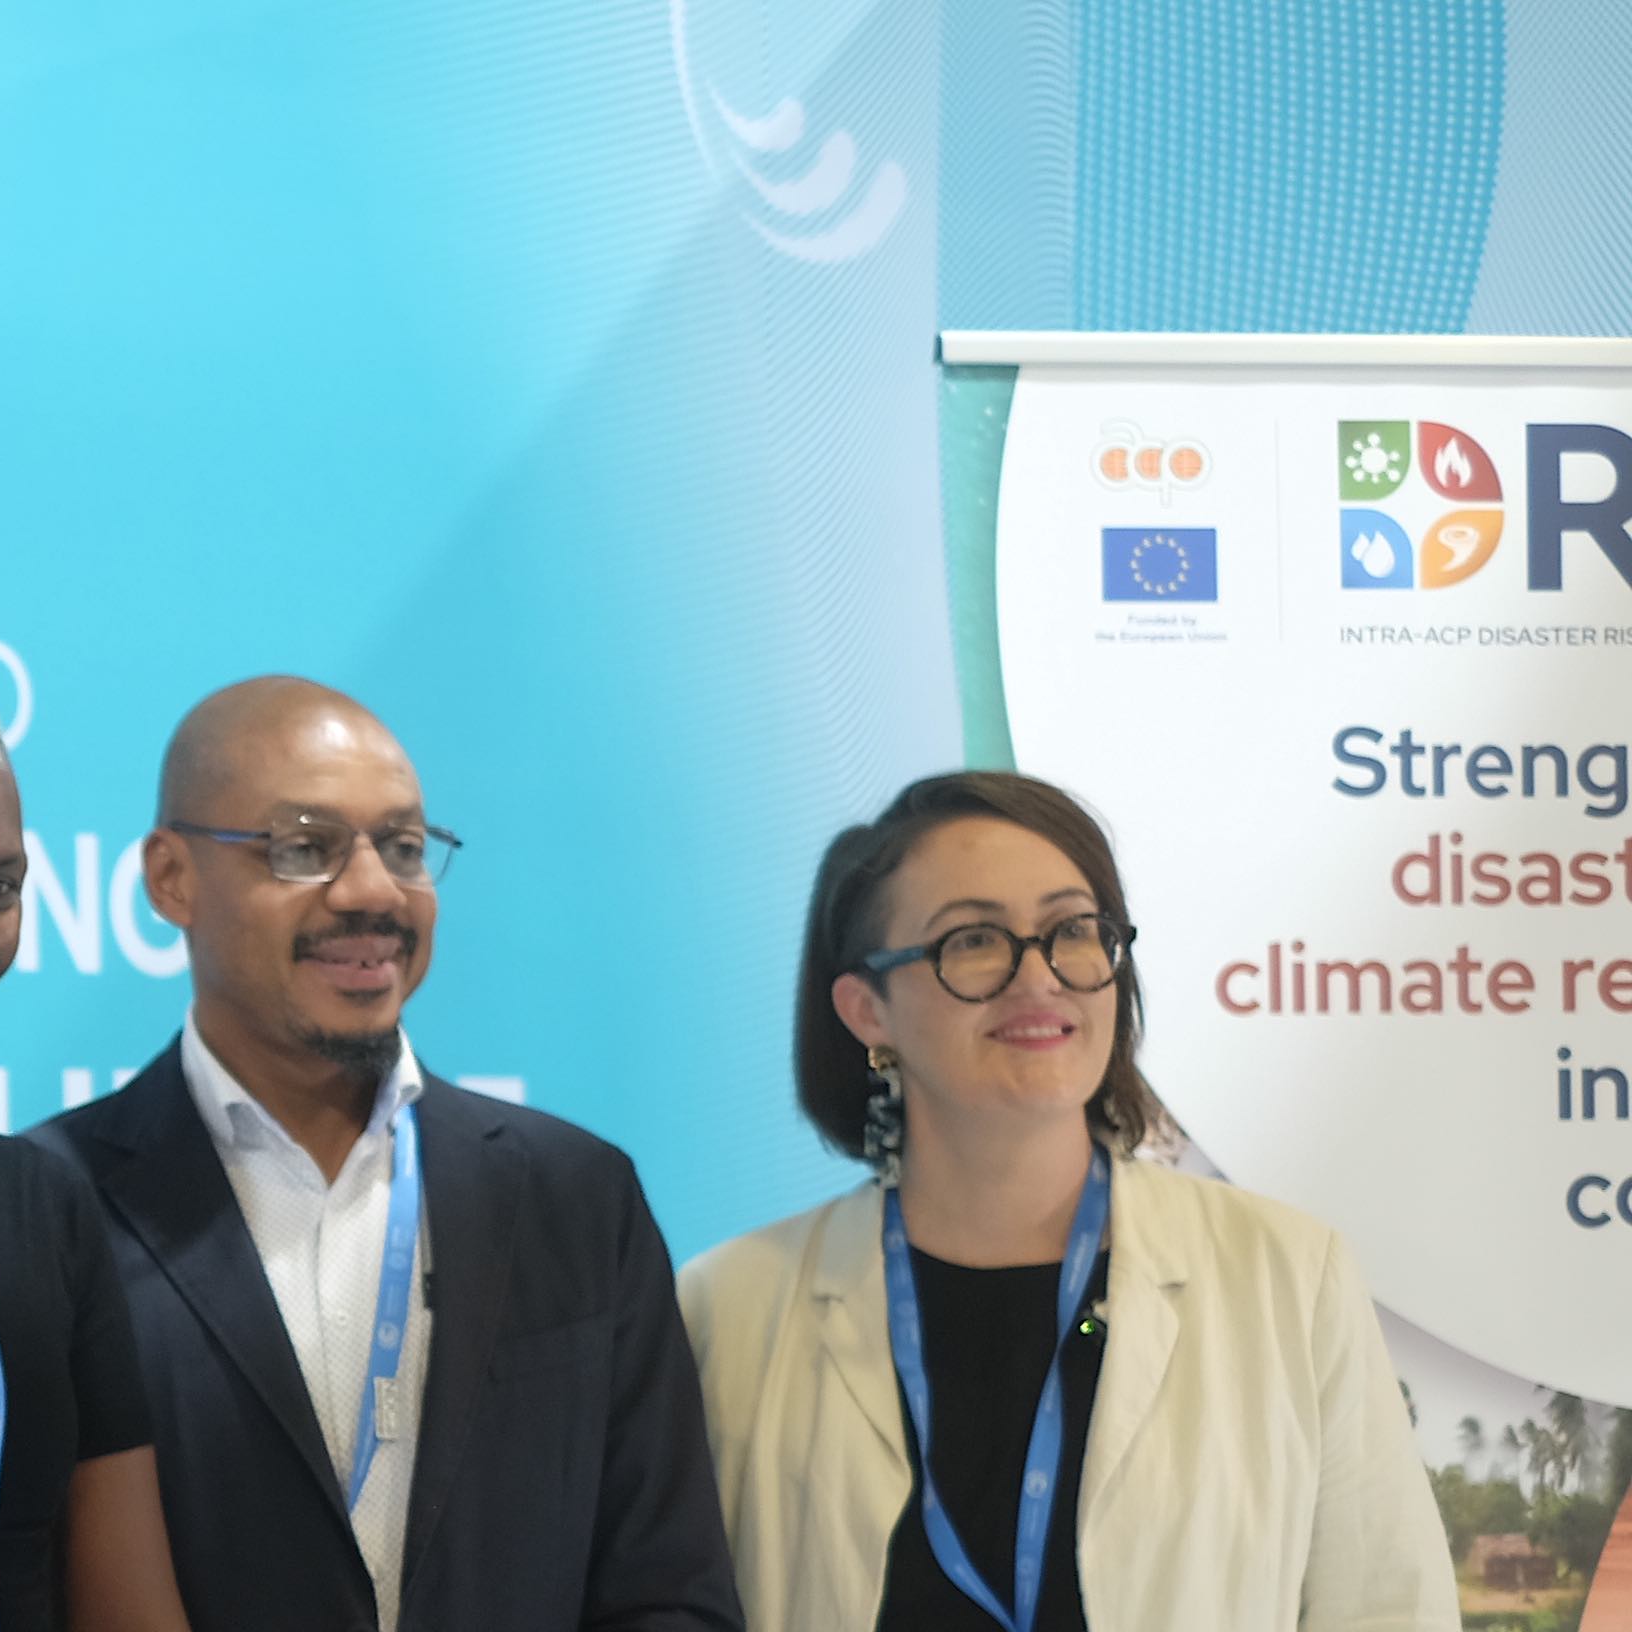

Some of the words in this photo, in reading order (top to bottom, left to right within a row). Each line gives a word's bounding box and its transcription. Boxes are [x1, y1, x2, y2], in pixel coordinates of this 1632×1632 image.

[1340, 626, 1472, 647] INTRA-ACP
[1479, 627, 1597, 647] DISASTER
[1331, 725, 1629, 819] Streng
[1214, 938, 1537, 1017] climate
[1556, 1045, 1631, 1122] in
